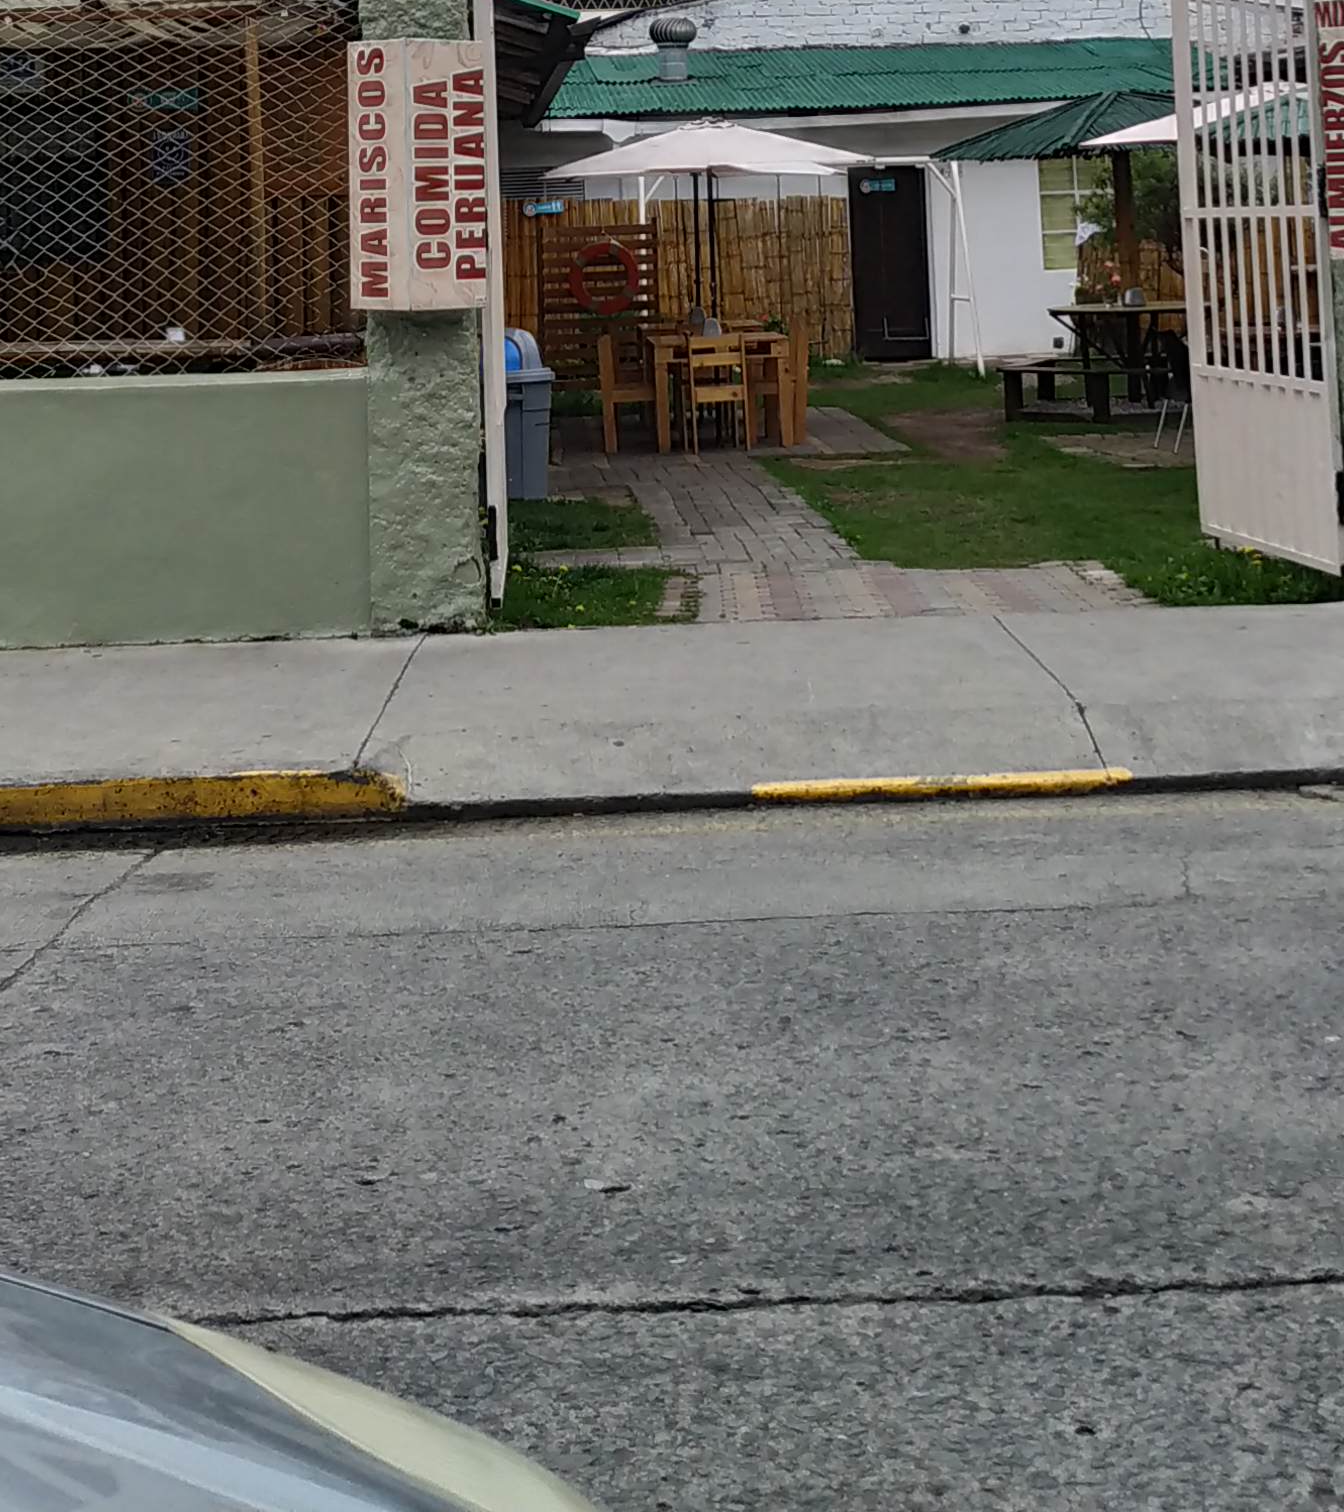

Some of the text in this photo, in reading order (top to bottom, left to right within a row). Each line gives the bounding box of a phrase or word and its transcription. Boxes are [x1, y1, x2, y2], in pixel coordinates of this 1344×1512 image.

[356, 47, 389, 299] MARISCOS
[413, 80, 452, 270] COMIDA
[452, 68, 487, 280] PERUANA
